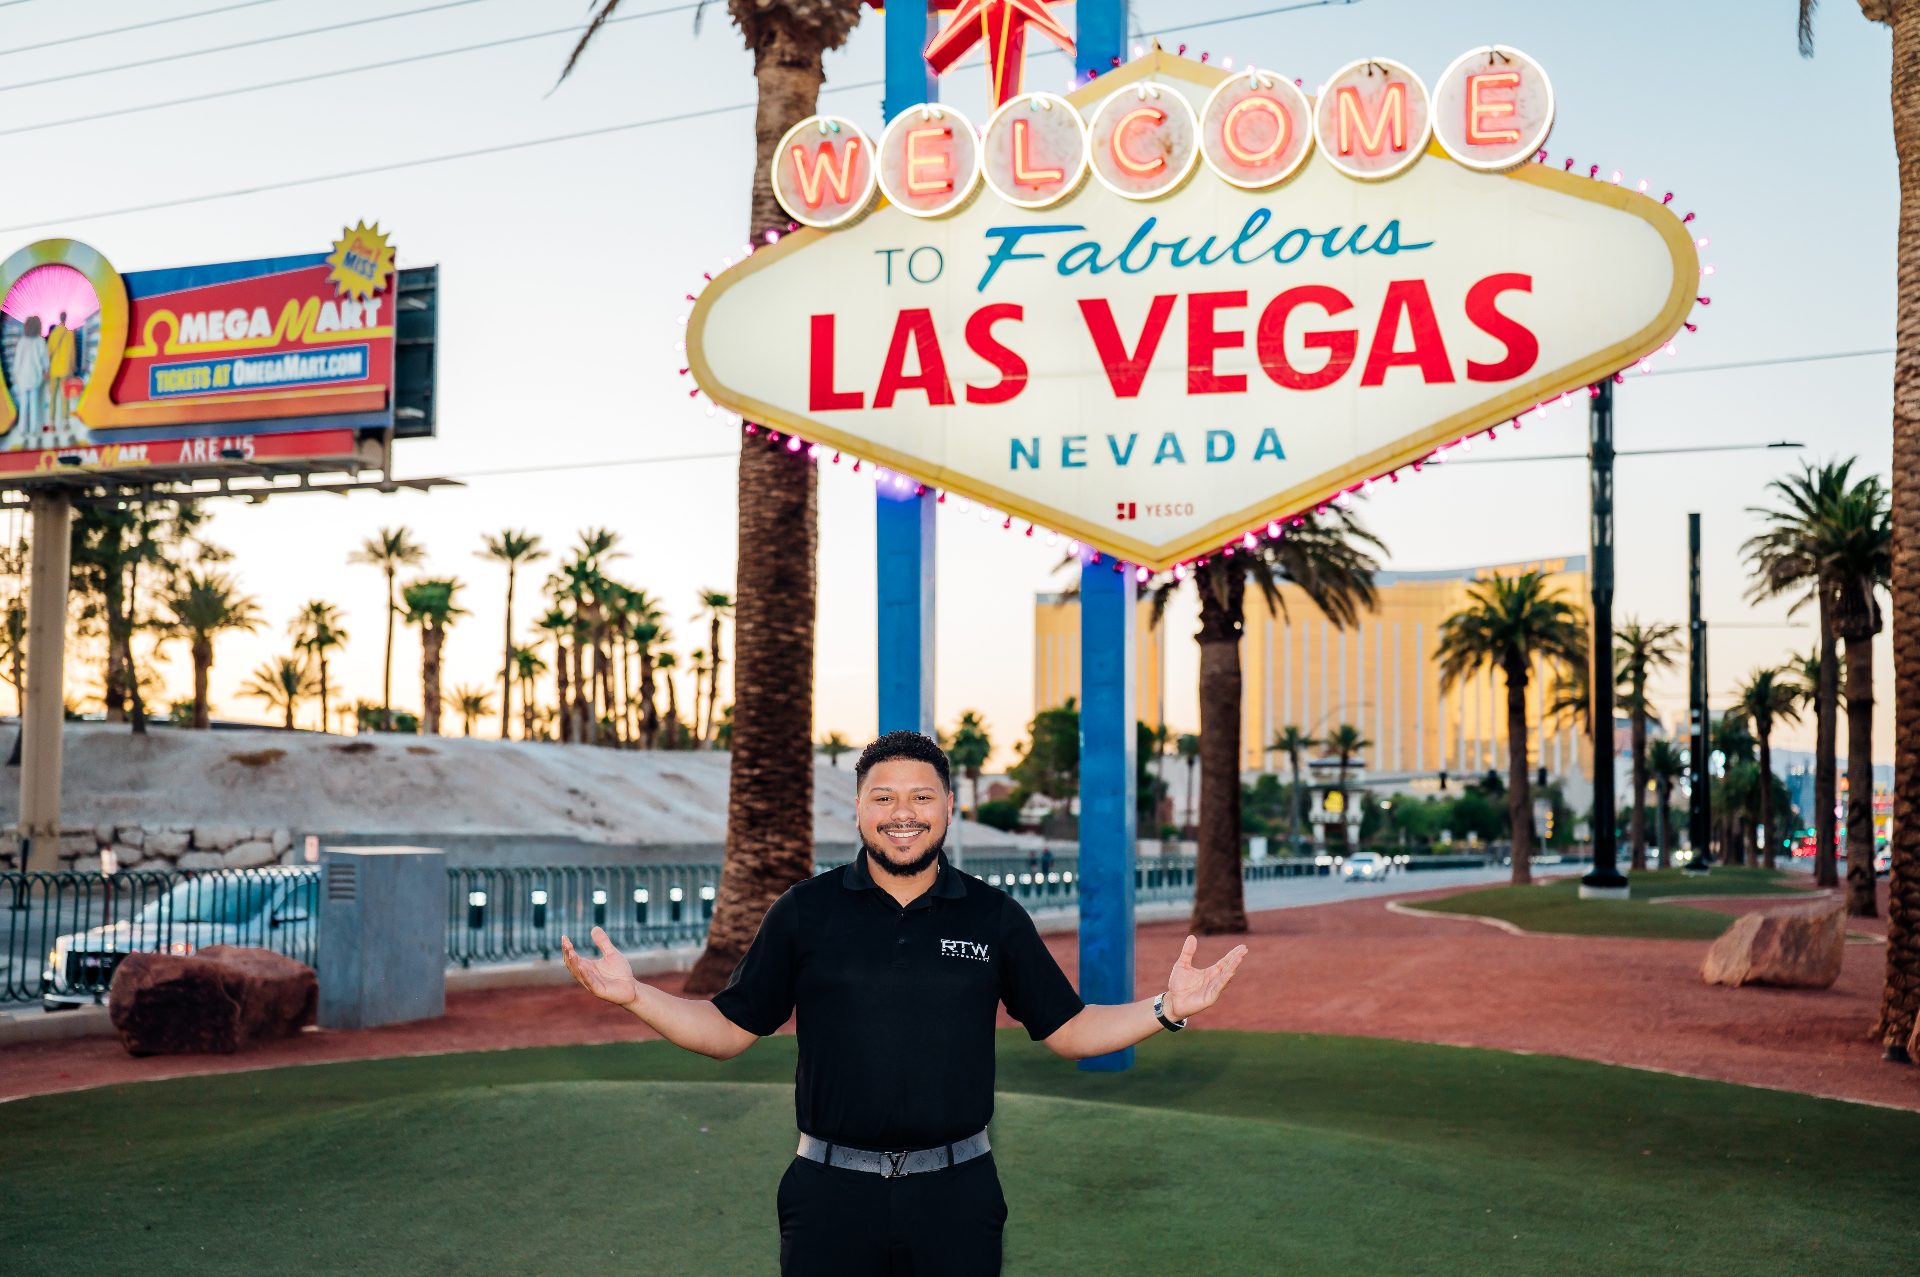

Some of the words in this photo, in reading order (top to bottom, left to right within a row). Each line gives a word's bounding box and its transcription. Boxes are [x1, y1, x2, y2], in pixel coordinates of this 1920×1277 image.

[791, 72, 1520, 210] WELCOME
[343, 250, 378, 281] MISS
[874, 246, 945, 286] TO
[977, 207, 1436, 292] Fabulous
[273, 296, 382, 345] MART
[808, 303, 1029, 411] LAS
[1077, 272, 1540, 398] VEGAS
[156, 364, 211, 393] TICKETS
[212, 363, 231, 388] AT
[1009, 427, 1287, 470] NEVADA
[1145, 503, 1194, 517] YESCO
[941, 939, 989, 958] RTW
